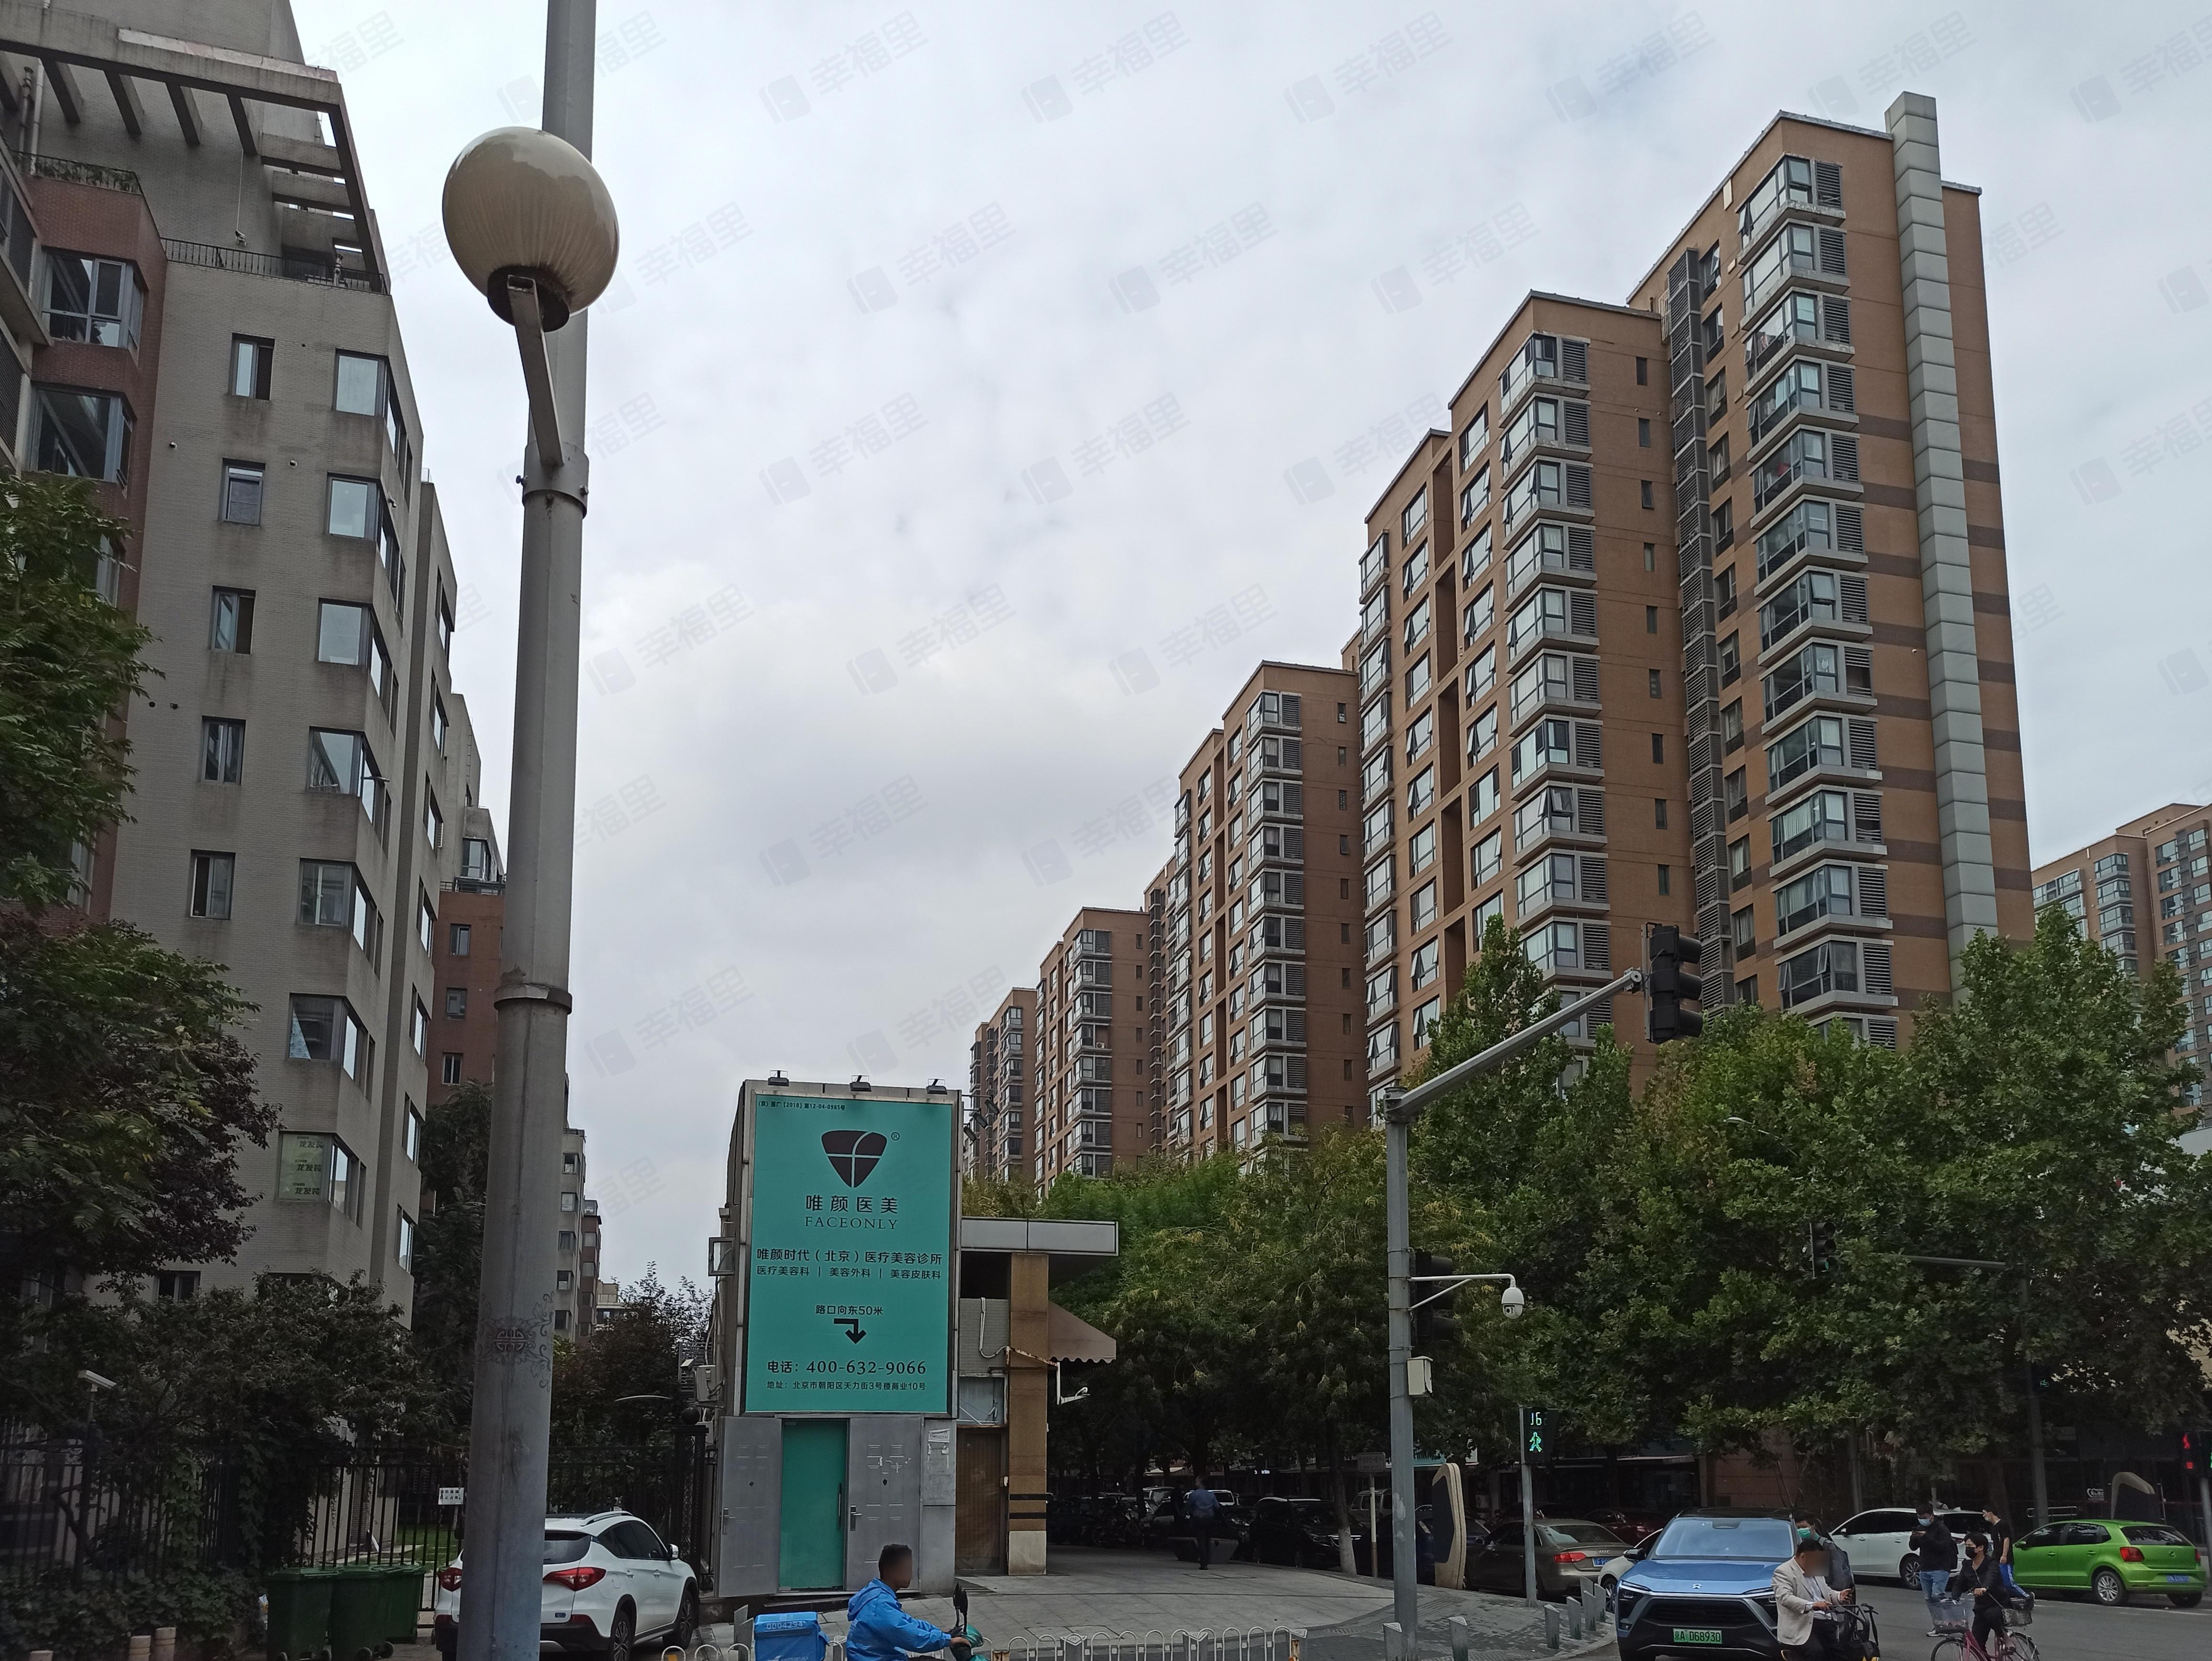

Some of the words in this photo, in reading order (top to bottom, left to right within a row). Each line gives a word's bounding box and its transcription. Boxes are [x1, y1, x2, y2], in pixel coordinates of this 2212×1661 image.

[806, 1195, 898, 1214] 唯颜医美
[805, 1217, 898, 1229] FACEONLY
[816, 1305, 883, 1316] 路口向东50米
